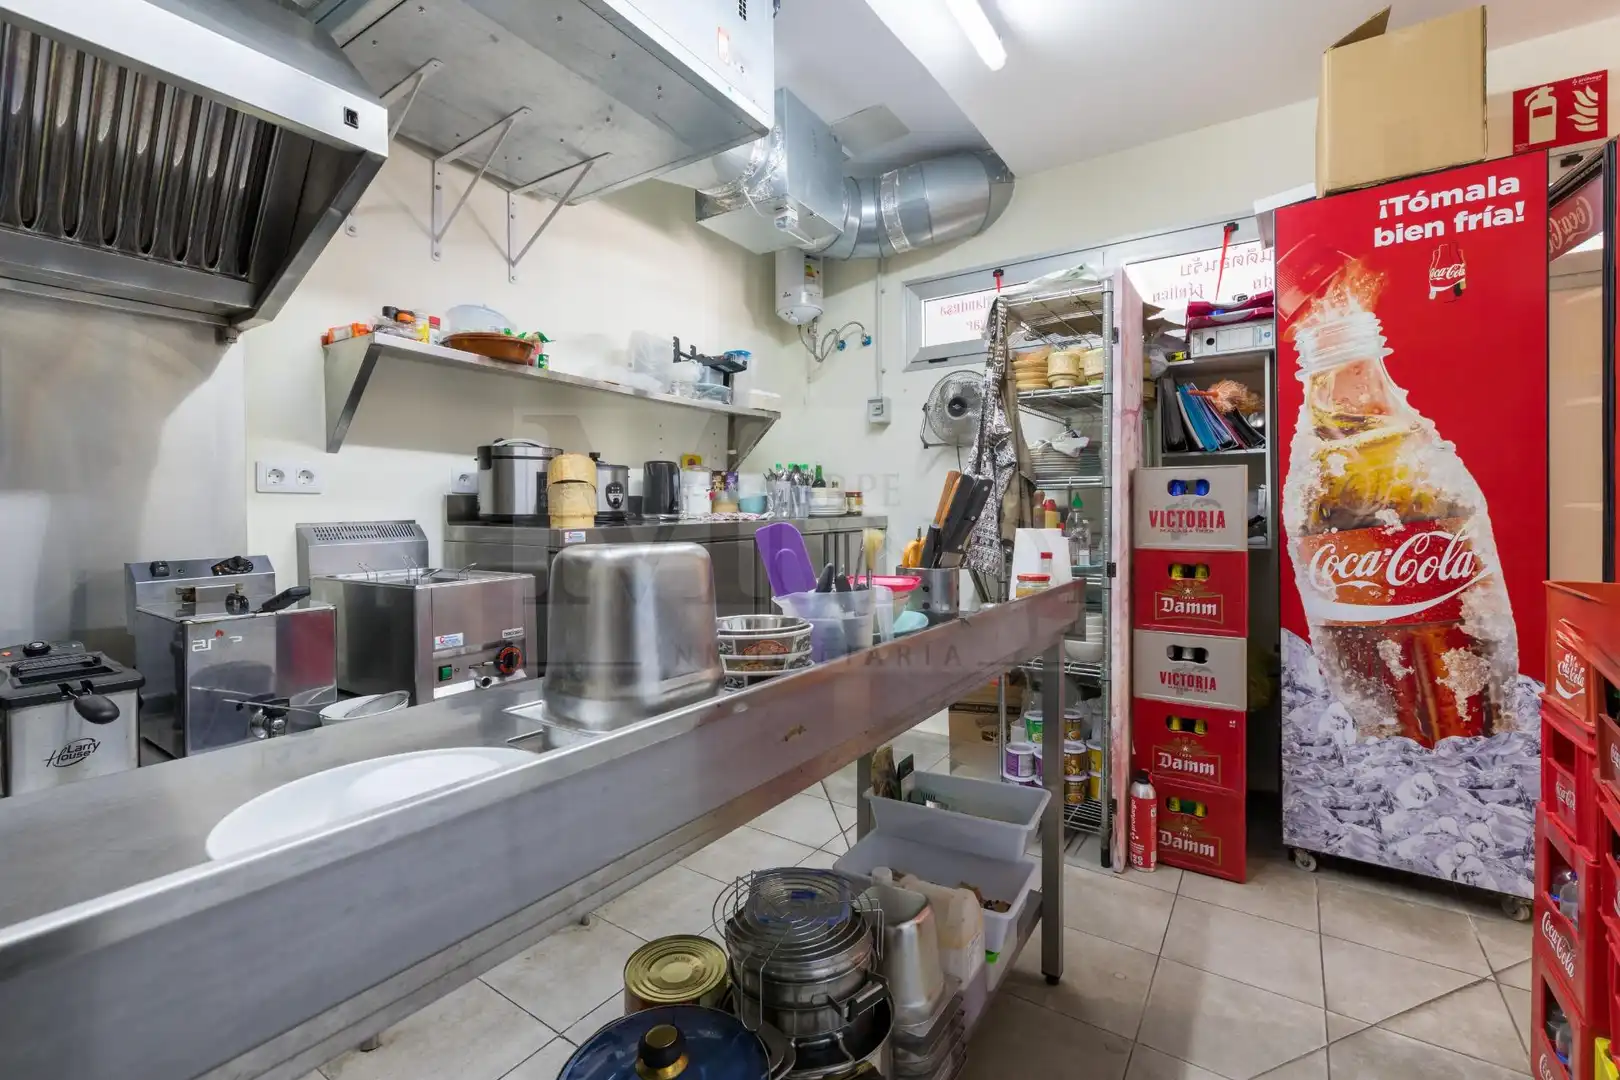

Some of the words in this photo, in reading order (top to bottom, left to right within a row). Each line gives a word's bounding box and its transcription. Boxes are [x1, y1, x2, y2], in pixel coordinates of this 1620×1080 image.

[1379, 175, 1520, 219] ¡Tómala
[1374, 220, 1445, 248] bien
[1453, 200, 1526, 234] fría!
[1148, 509, 1227, 529] VICTORIA
[1309, 528, 1475, 591] Coca-Cola
[1160, 596, 1218, 617] Damm
[1159, 671, 1217, 692] VICTORIA
[43, 749, 91, 768] House
[66, 741, 101, 753] Larry
[1158, 752, 1215, 777] Damm
[1159, 829, 1216, 858] Damm
